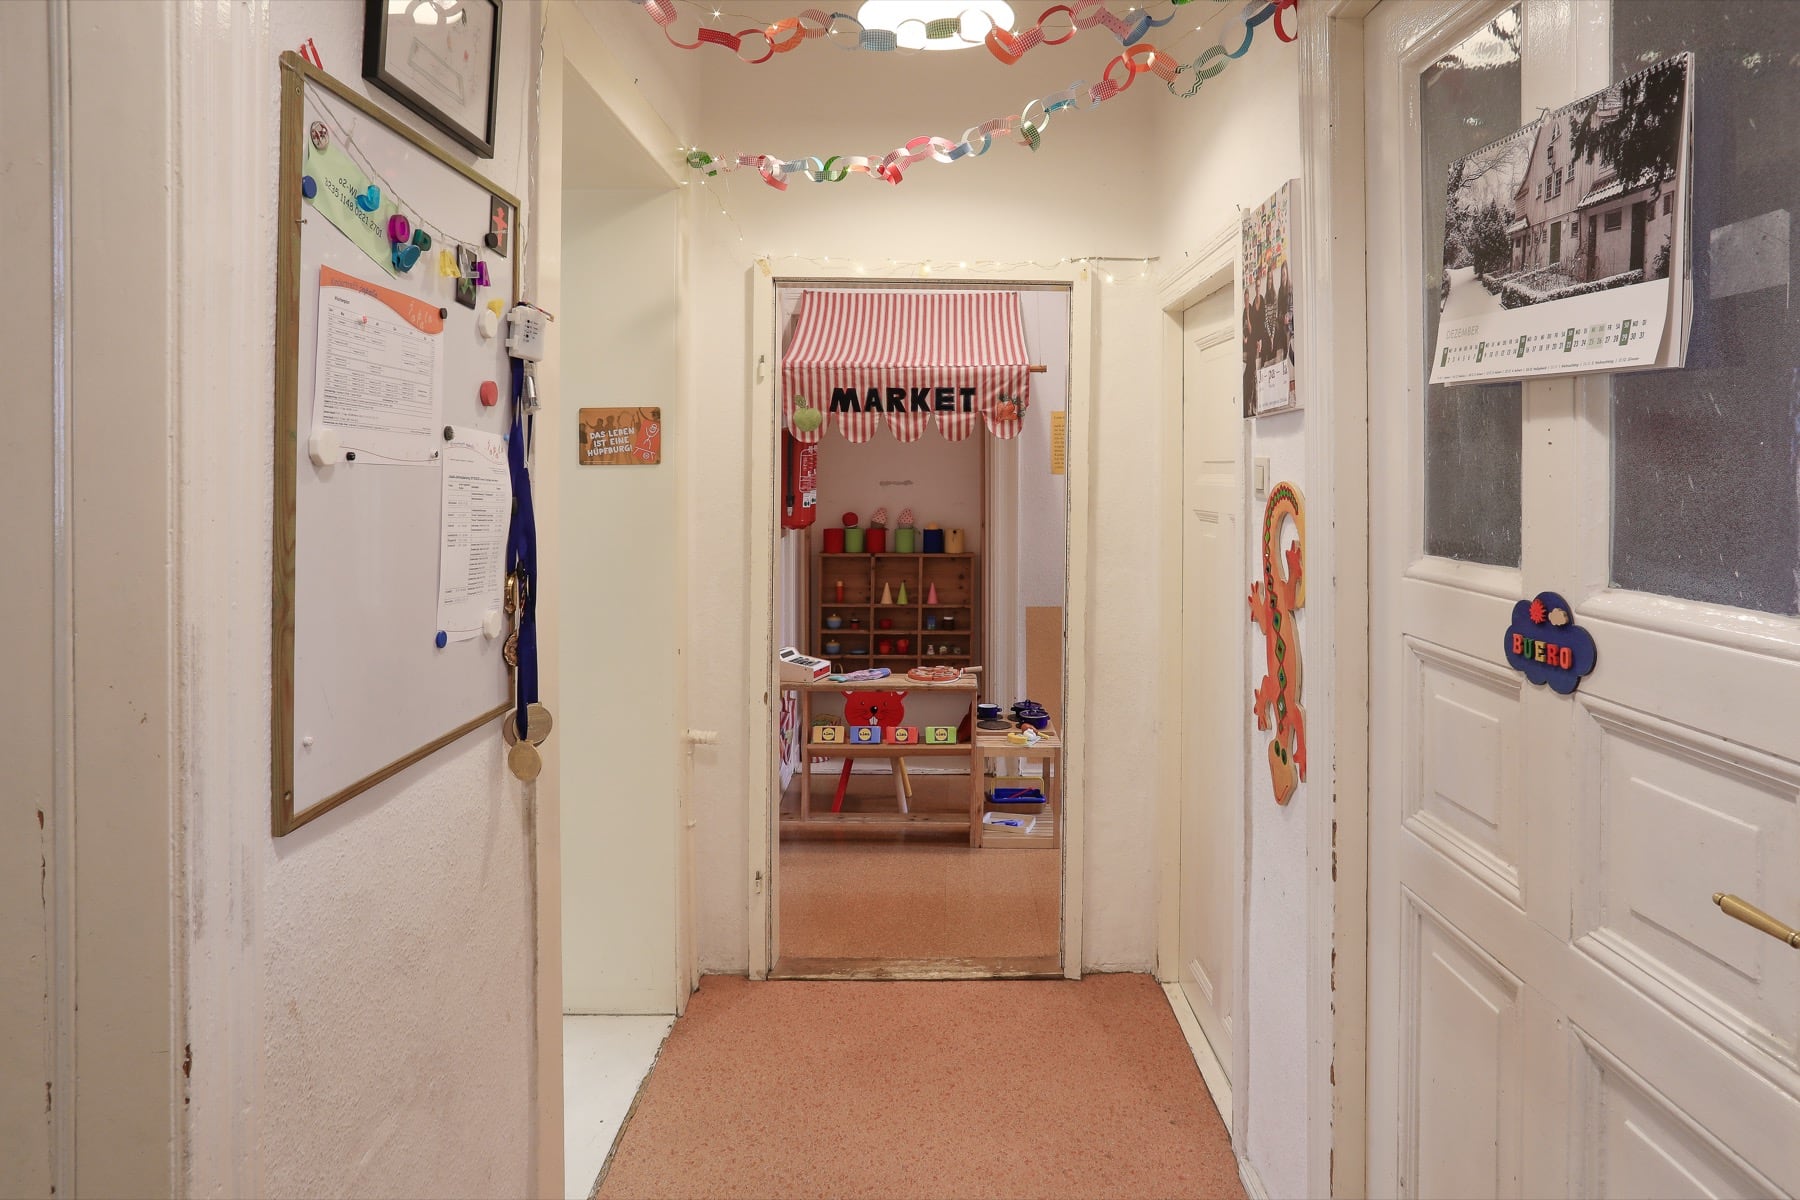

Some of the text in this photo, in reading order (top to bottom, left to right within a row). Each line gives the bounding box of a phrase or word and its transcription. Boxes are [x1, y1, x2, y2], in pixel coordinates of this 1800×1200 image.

[829, 387, 977, 413] MARKET
[589, 427, 635, 440] DAS LEBEN
[593, 436, 630, 448] IST EINE
[1512, 633, 1573, 670] BUERO
